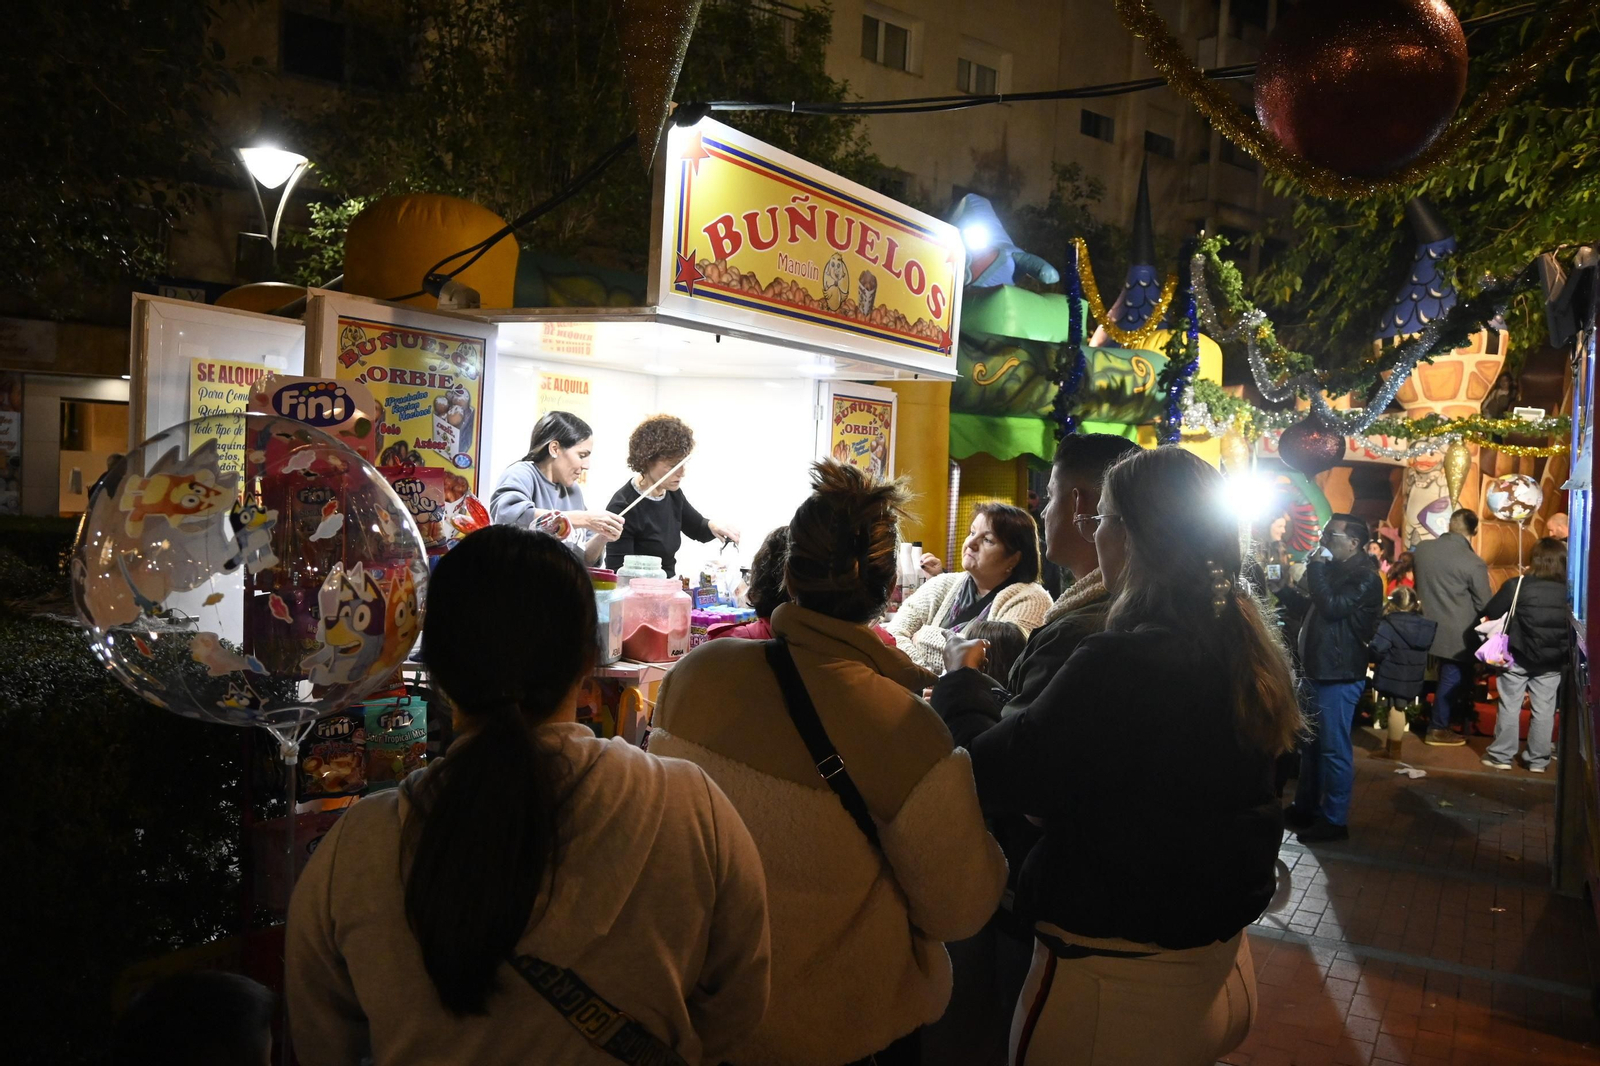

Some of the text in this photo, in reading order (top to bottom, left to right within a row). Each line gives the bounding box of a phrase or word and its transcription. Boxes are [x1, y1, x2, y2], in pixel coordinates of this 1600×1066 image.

[703, 195, 946, 320] BUÑUELOS
[197, 363, 215, 382] SE
[541, 376, 589, 395] SE ALQUILA
[198, 387, 225, 402] Para
[281, 387, 346, 421] Fini
[220, 452, 240, 461] elos,
[220, 462, 237, 471] dón
[395, 479, 422, 494] Fini
[318, 716, 350, 737] Fini
[381, 711, 410, 728] Fini
[384, 732, 411, 744] Tropical
[412, 728, 426, 739] Mix
